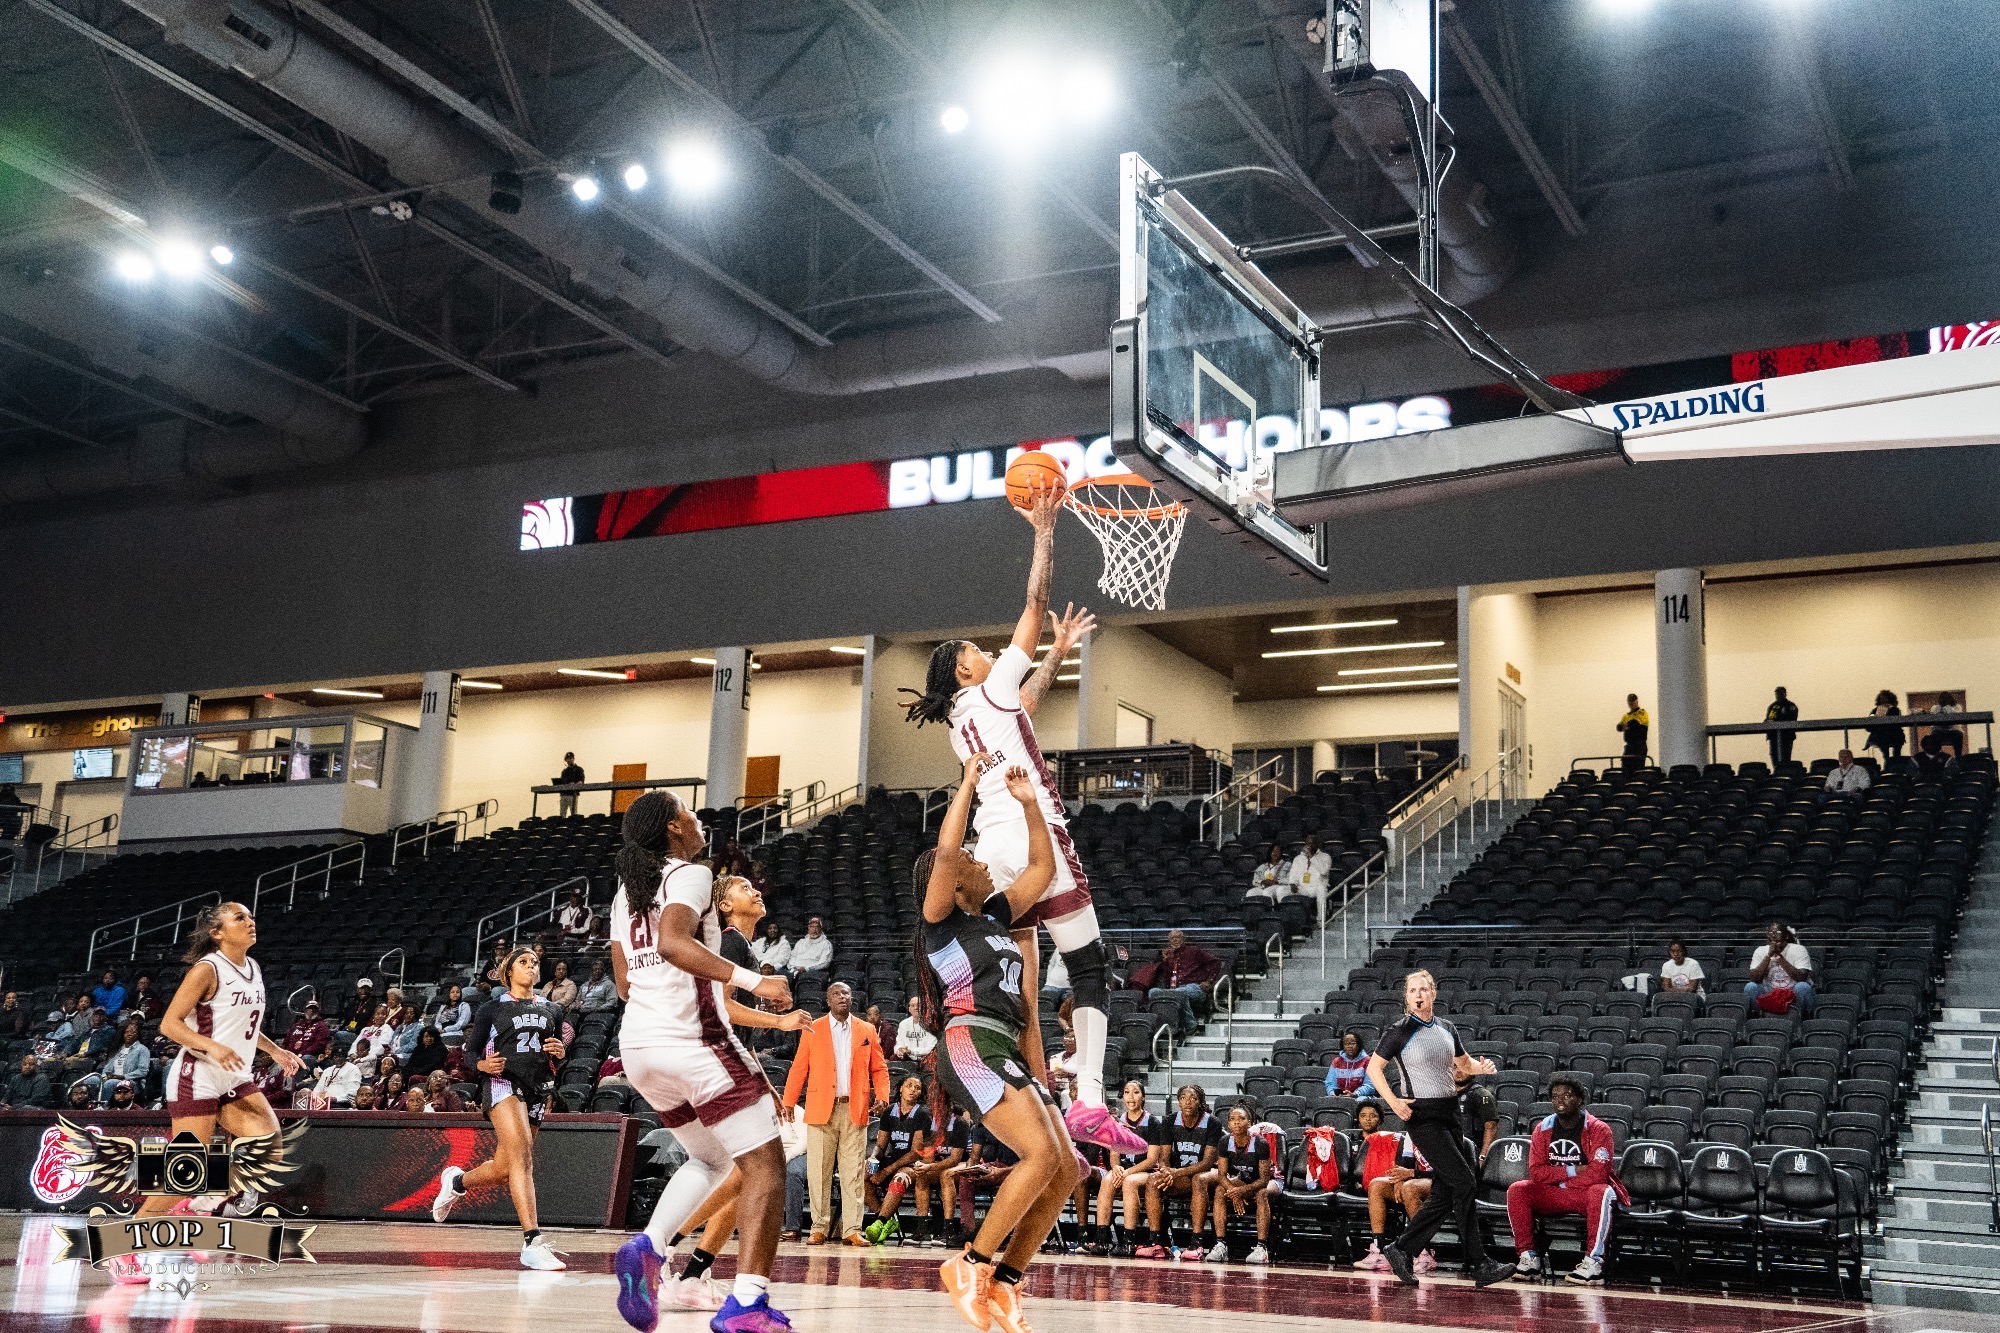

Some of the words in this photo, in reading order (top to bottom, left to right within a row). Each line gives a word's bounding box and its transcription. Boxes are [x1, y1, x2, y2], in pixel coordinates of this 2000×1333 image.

[1613, 382, 1765, 433] SPALDING
[1663, 594, 1689, 624] 114
[714, 667, 732, 693] 112
[422, 691, 437, 714] 111
[25, 720, 62, 738] The
[961, 717, 988, 755] 11
[625, 951, 666, 971] CINTOS
[999, 957, 1022, 995] 10
[231, 990, 254, 1007] The
[245, 1009, 260, 1040] 3
[516, 1031, 542, 1053] 24
